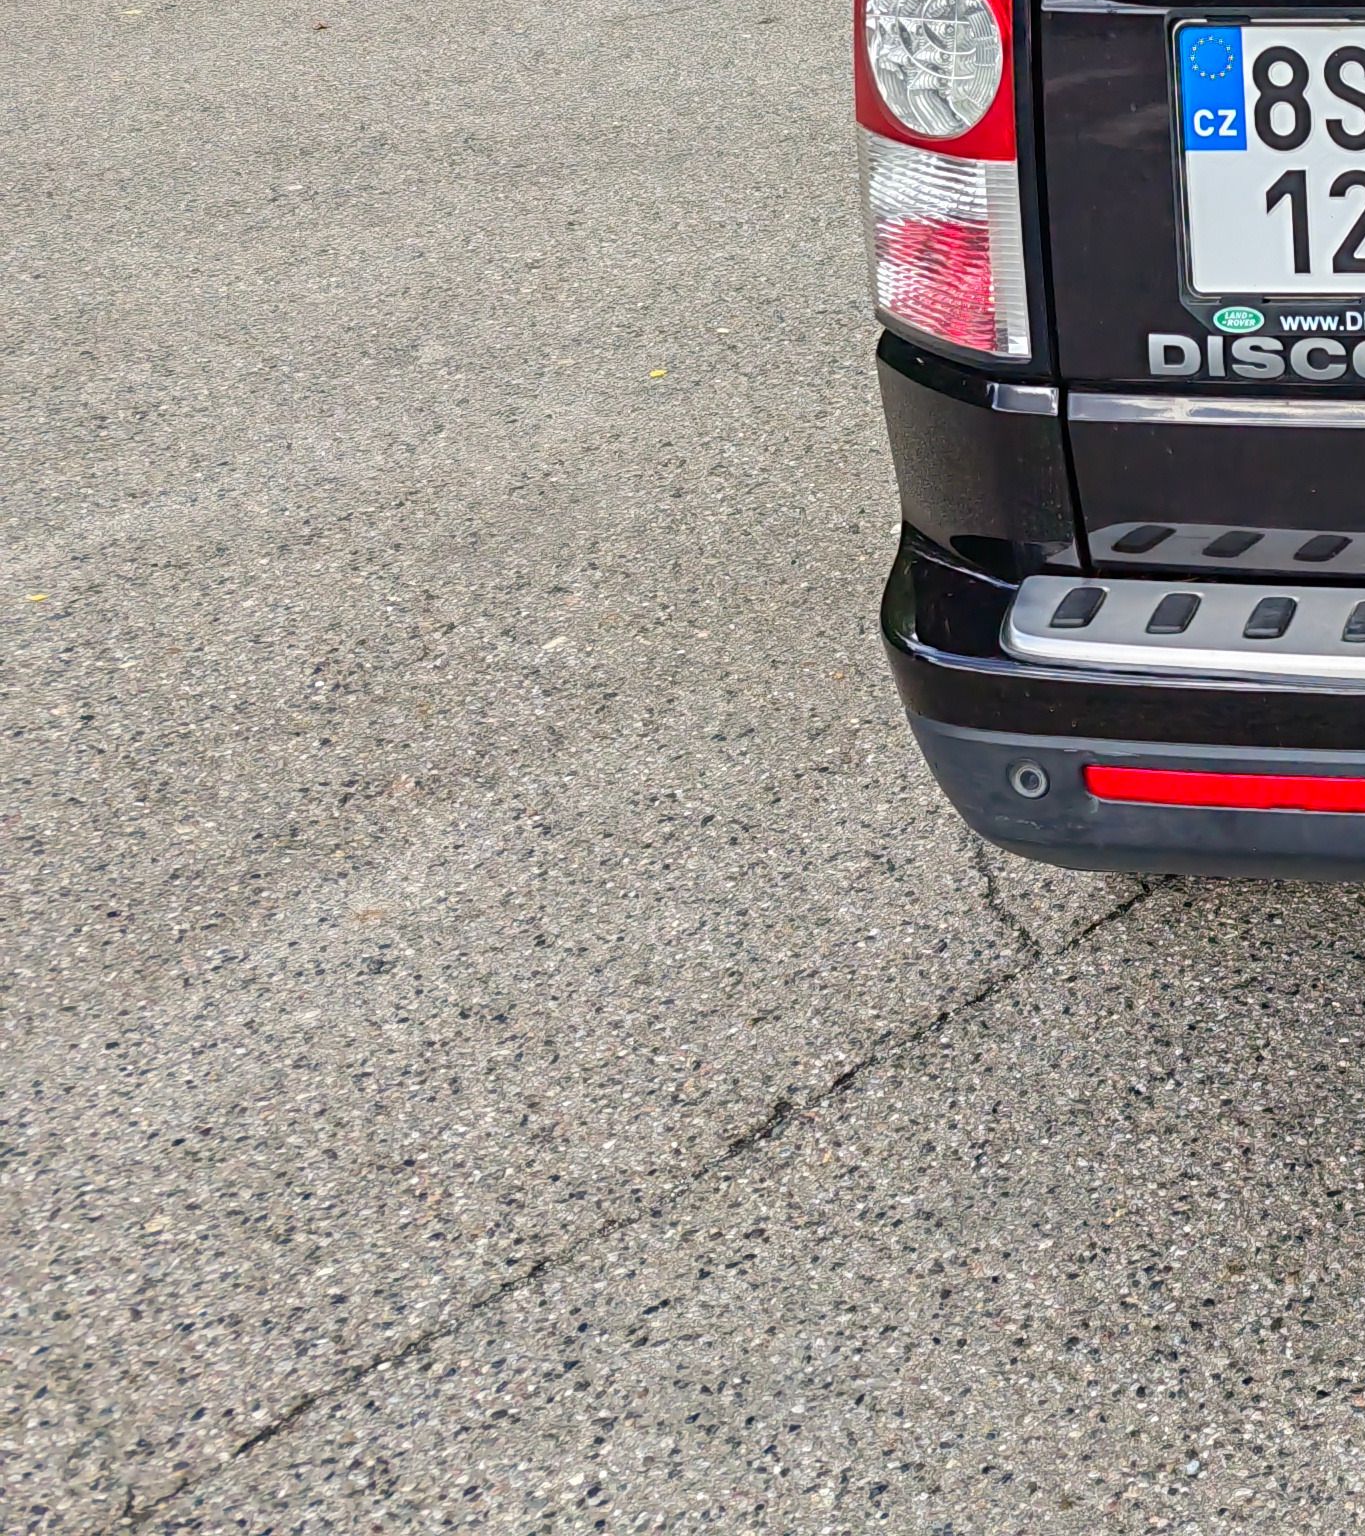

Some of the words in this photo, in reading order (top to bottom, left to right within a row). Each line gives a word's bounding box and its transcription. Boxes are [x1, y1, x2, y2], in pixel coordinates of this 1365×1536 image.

[1193, 108, 1238, 137] CZ
[1224, 311, 1248, 320] LAND
[1226, 318, 1257, 328] ROVER
